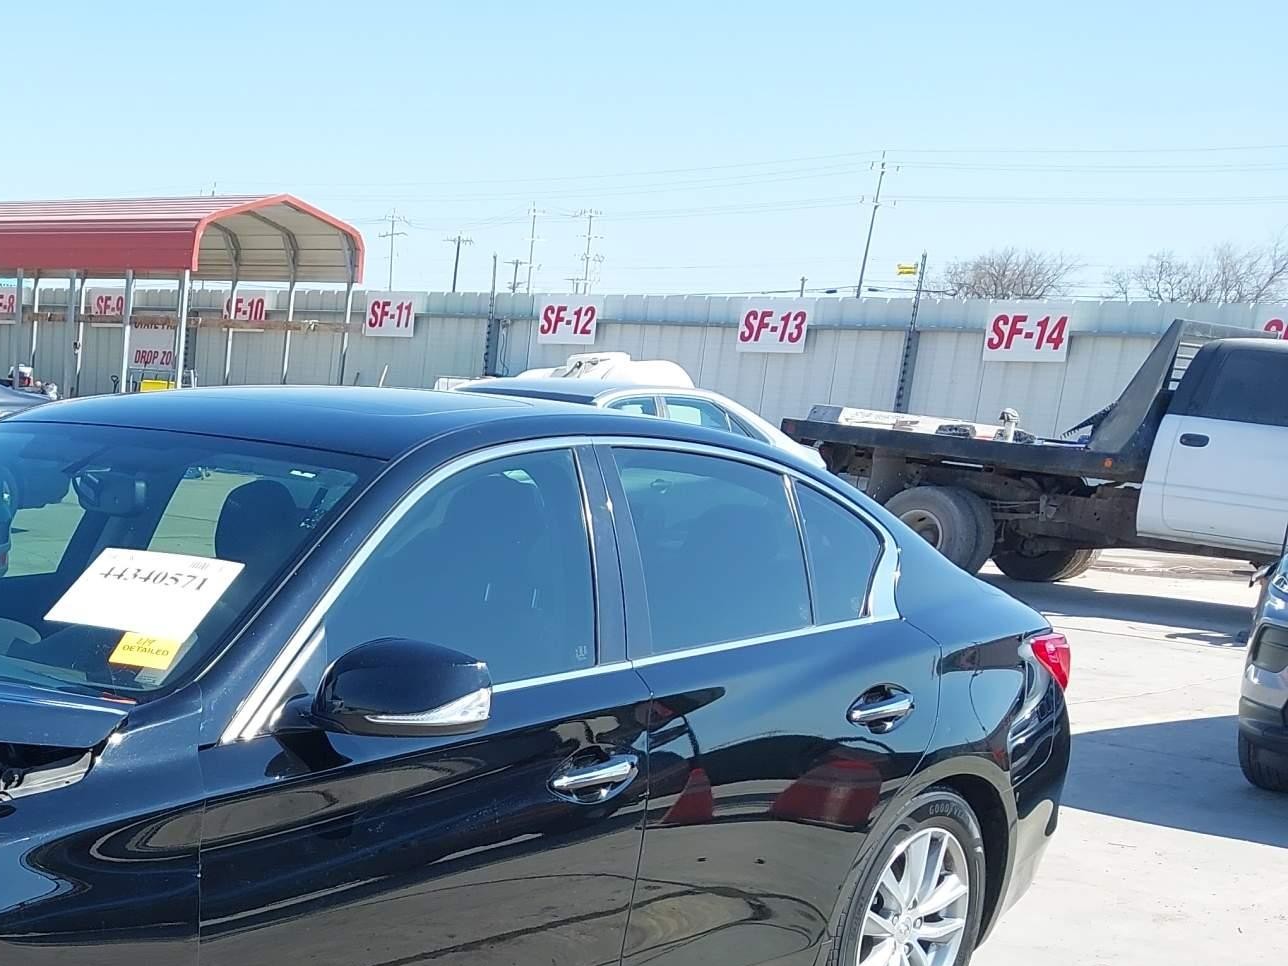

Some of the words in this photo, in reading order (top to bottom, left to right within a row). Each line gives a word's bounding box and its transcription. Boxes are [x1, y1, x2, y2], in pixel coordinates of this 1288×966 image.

[368, 300, 413, 328] SF-11
[540, 305, 596, 335] SF-12
[739, 310, 807, 343] SF-13
[987, 314, 1070, 351] SF-14
[134, 350, 159, 365] DROP
[160, 351, 174, 365] ZO
[99, 566, 209, 591] 44340571
[122, 645, 170, 657] DETAILED
